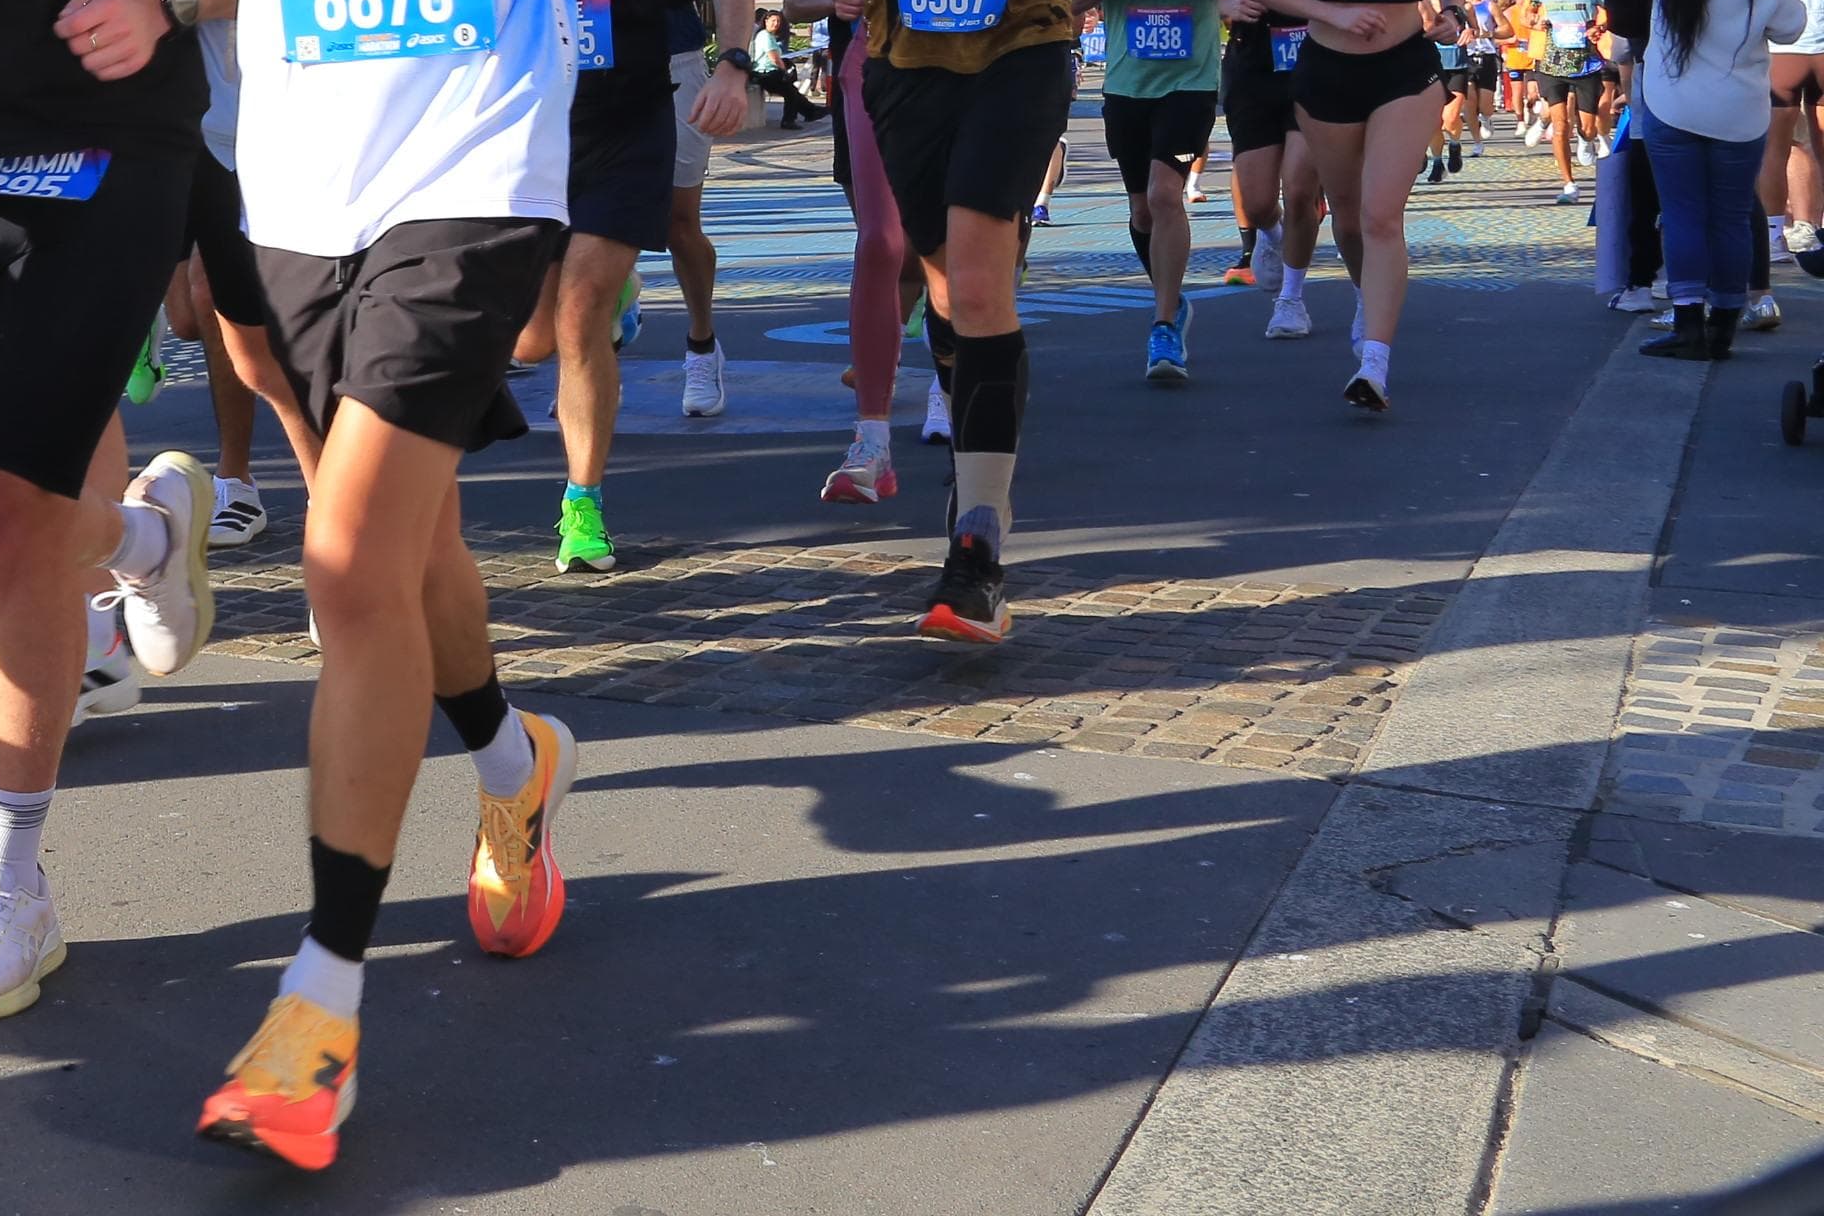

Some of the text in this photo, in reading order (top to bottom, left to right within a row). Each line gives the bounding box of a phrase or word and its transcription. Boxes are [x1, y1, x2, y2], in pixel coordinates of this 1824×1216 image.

[1145, 15, 1170, 26] JUGS
[1135, 26, 1182, 50] 9438
[1289, 31, 1307, 43] SHA
[1278, 42, 1302, 63] 14
